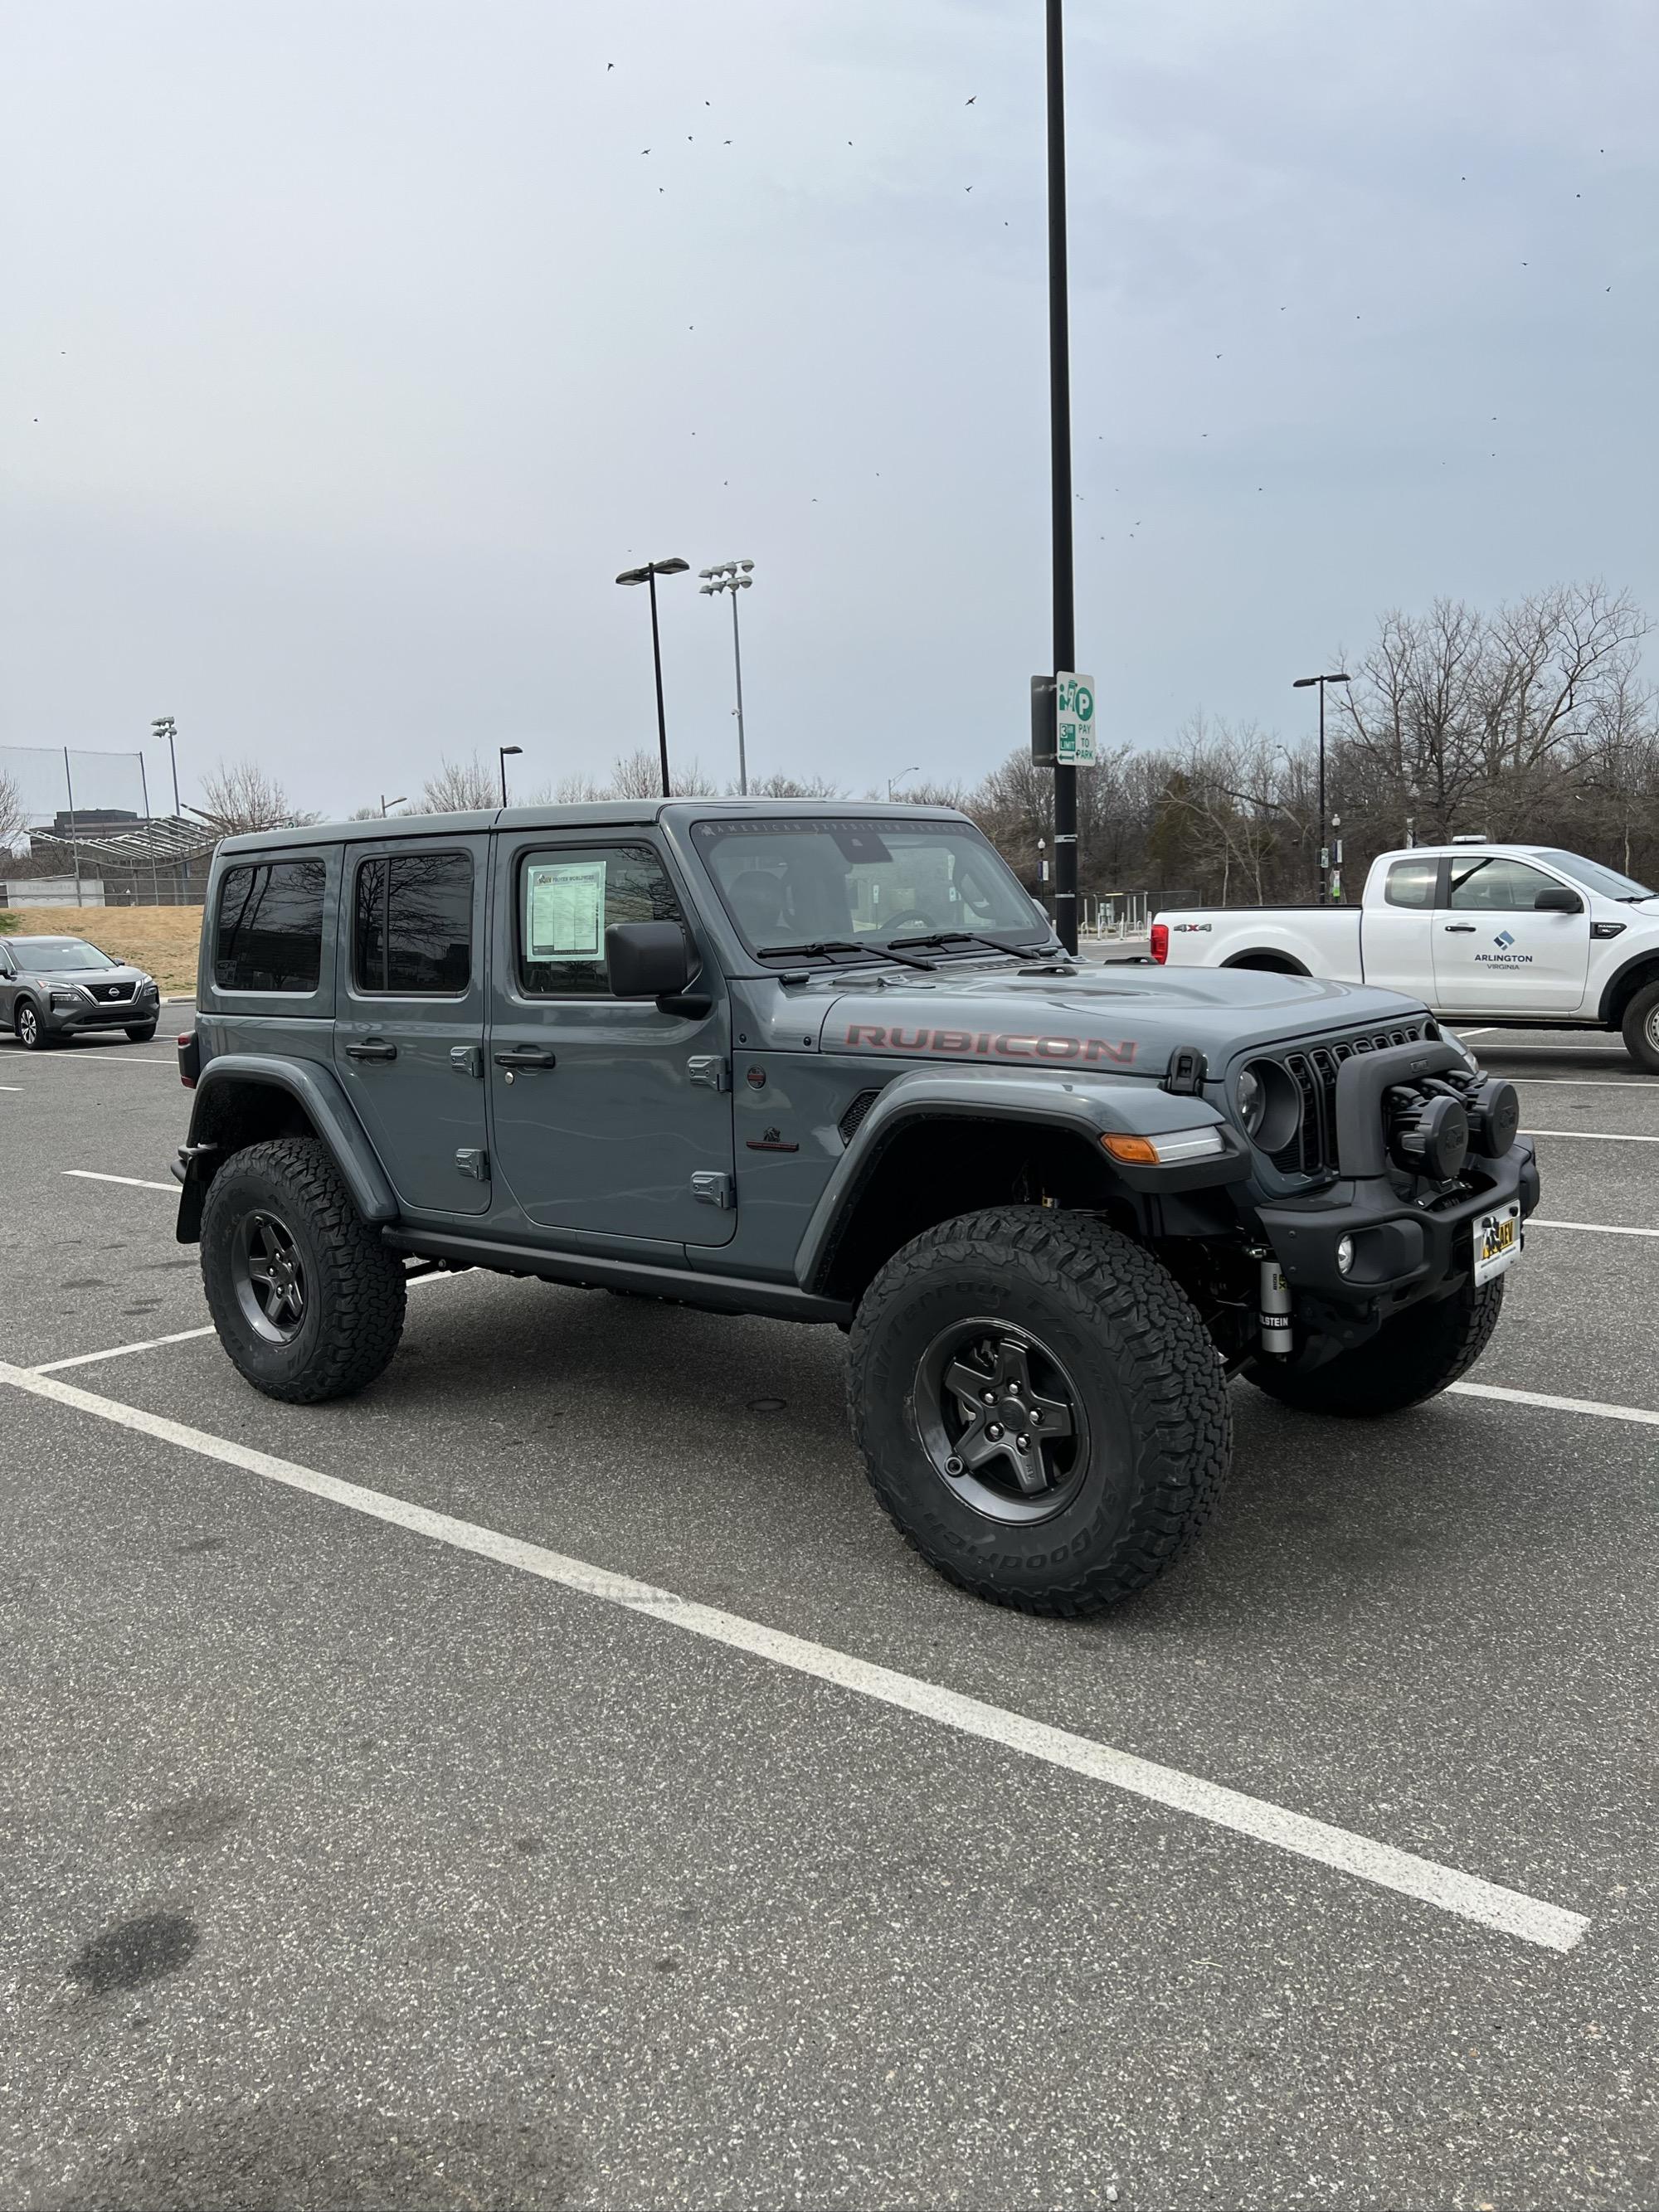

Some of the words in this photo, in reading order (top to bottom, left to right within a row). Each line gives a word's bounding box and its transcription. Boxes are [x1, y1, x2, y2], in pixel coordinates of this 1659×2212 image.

[1078, 724, 1092, 735] PAY
[1081, 737, 1090, 748] TO
[1077, 749, 1094, 760] PARK
[1474, 954, 1533, 963] ARLINGTON
[846, 1024, 1137, 1065] RUBICON
